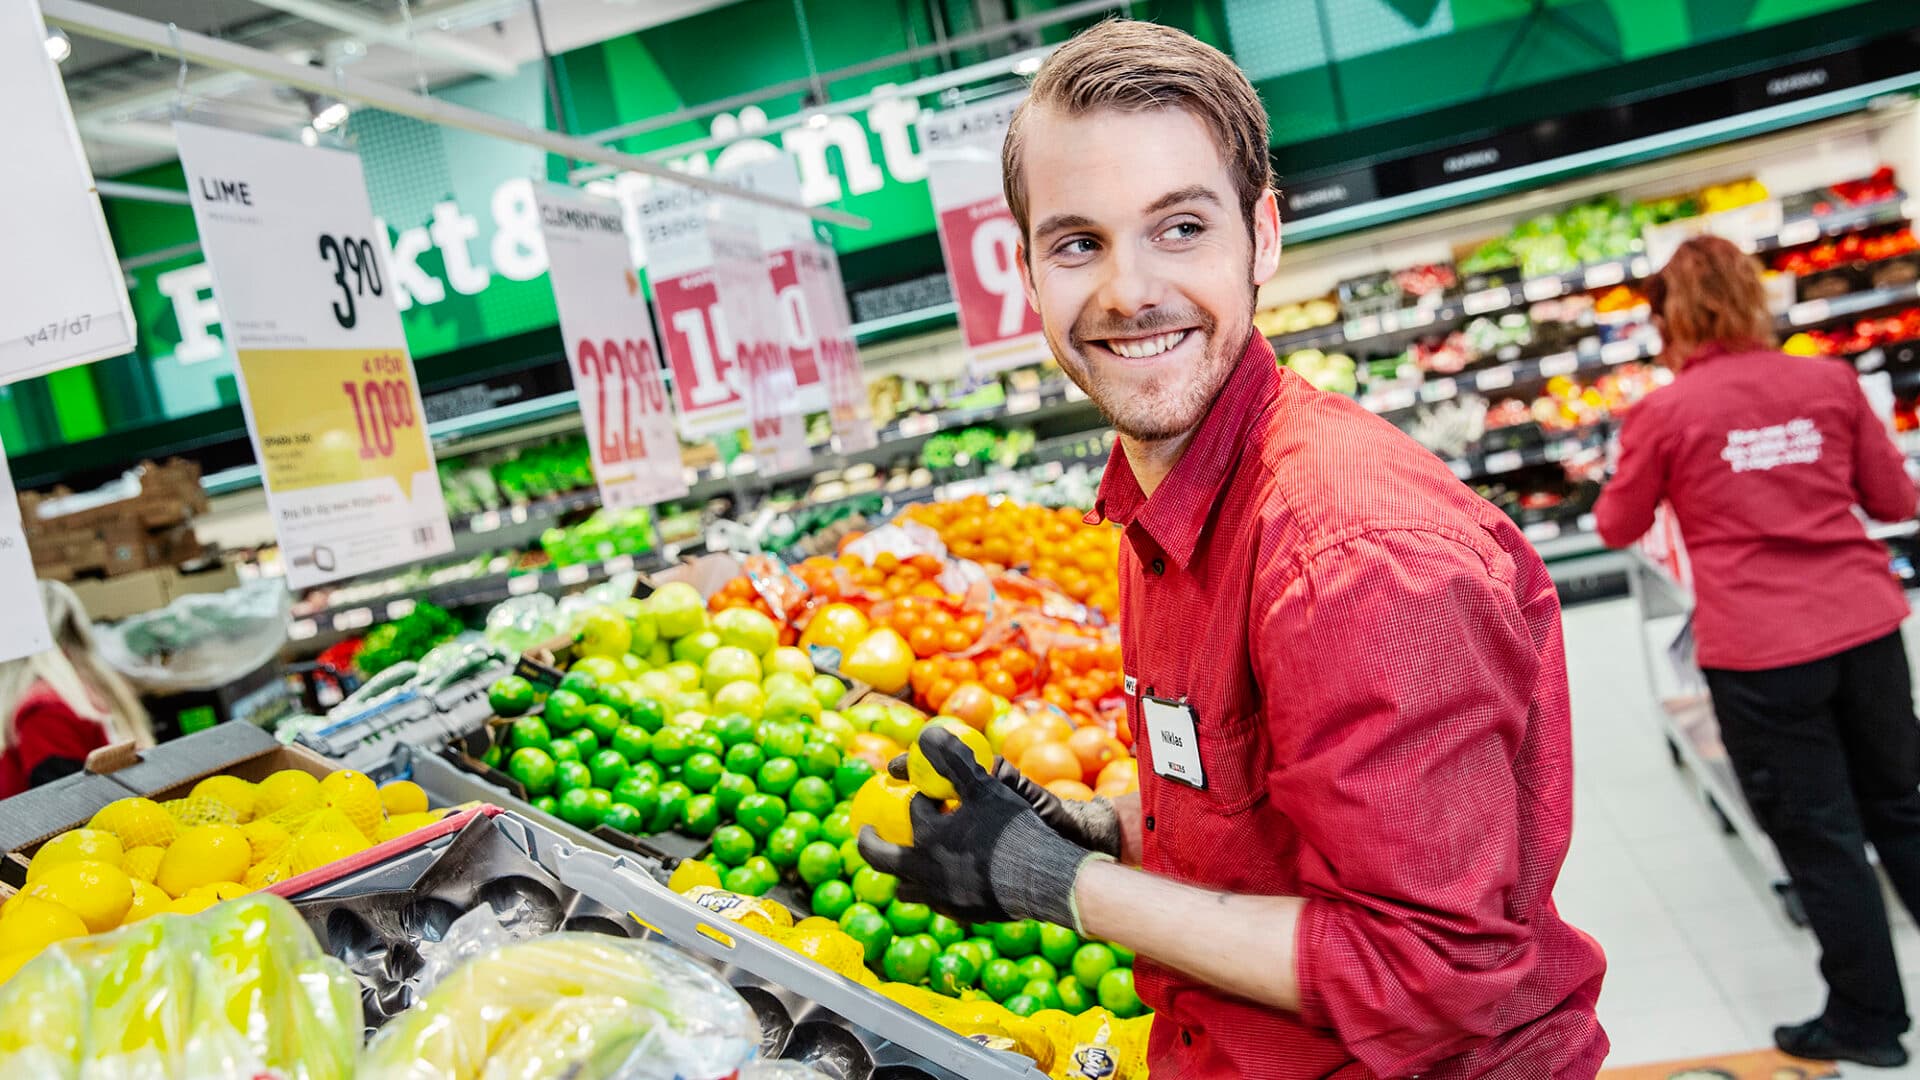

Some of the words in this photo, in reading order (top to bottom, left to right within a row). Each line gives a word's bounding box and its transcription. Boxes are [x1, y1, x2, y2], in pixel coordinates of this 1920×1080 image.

[199, 176, 253, 206] LIME
[24, 314, 92, 348] v47/d7
[1161, 730, 1183, 747] Niklas
